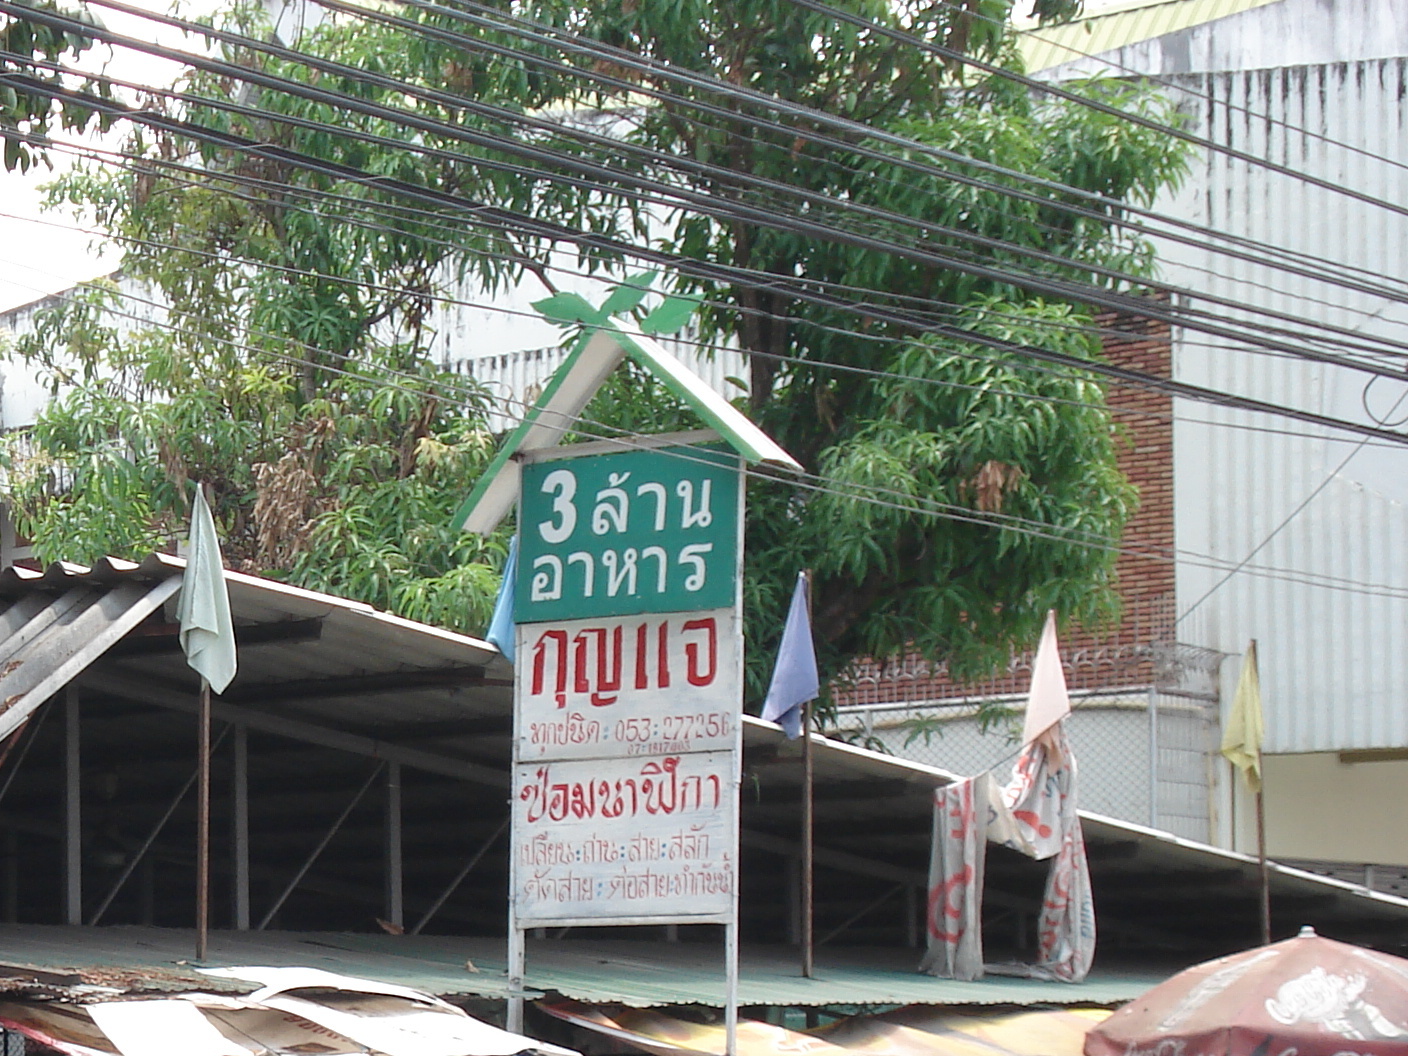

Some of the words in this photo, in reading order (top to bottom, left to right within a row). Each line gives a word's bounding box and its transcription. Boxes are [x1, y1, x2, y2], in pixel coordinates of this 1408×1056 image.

[537, 469, 578, 544] 3
[593, 471, 713, 536] ล้าน
[530, 541, 714, 602] อาหาร
[531, 616, 718, 710] กุญแจ
[519, 756, 721, 824] ซ่อมนาฬิกา
